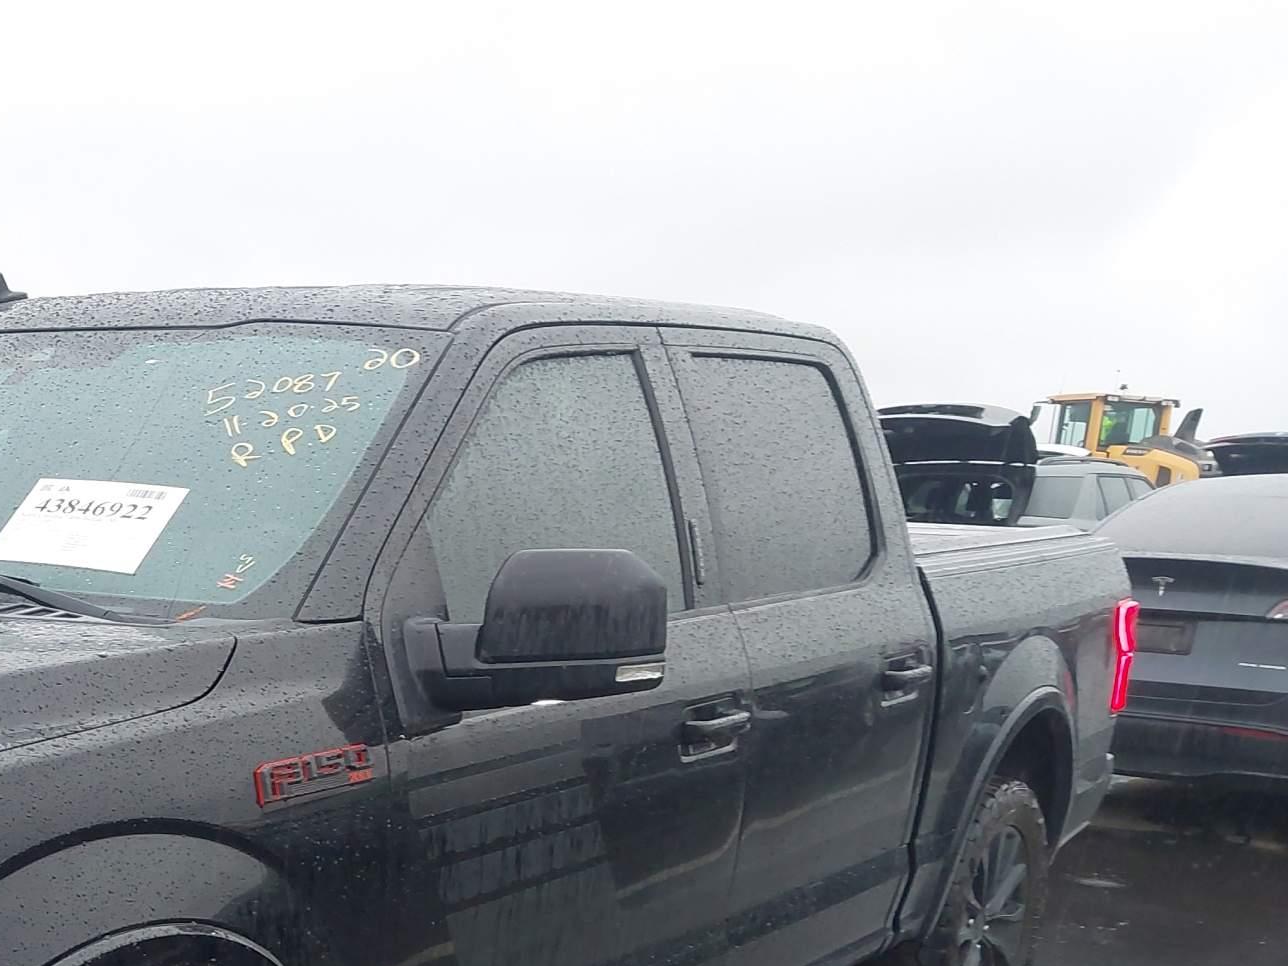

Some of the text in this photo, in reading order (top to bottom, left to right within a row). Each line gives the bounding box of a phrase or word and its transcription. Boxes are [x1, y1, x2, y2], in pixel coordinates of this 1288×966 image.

[363, 347, 420, 370] 20
[203, 371, 342, 417] 52087
[34, 497, 153, 520] 43846922
